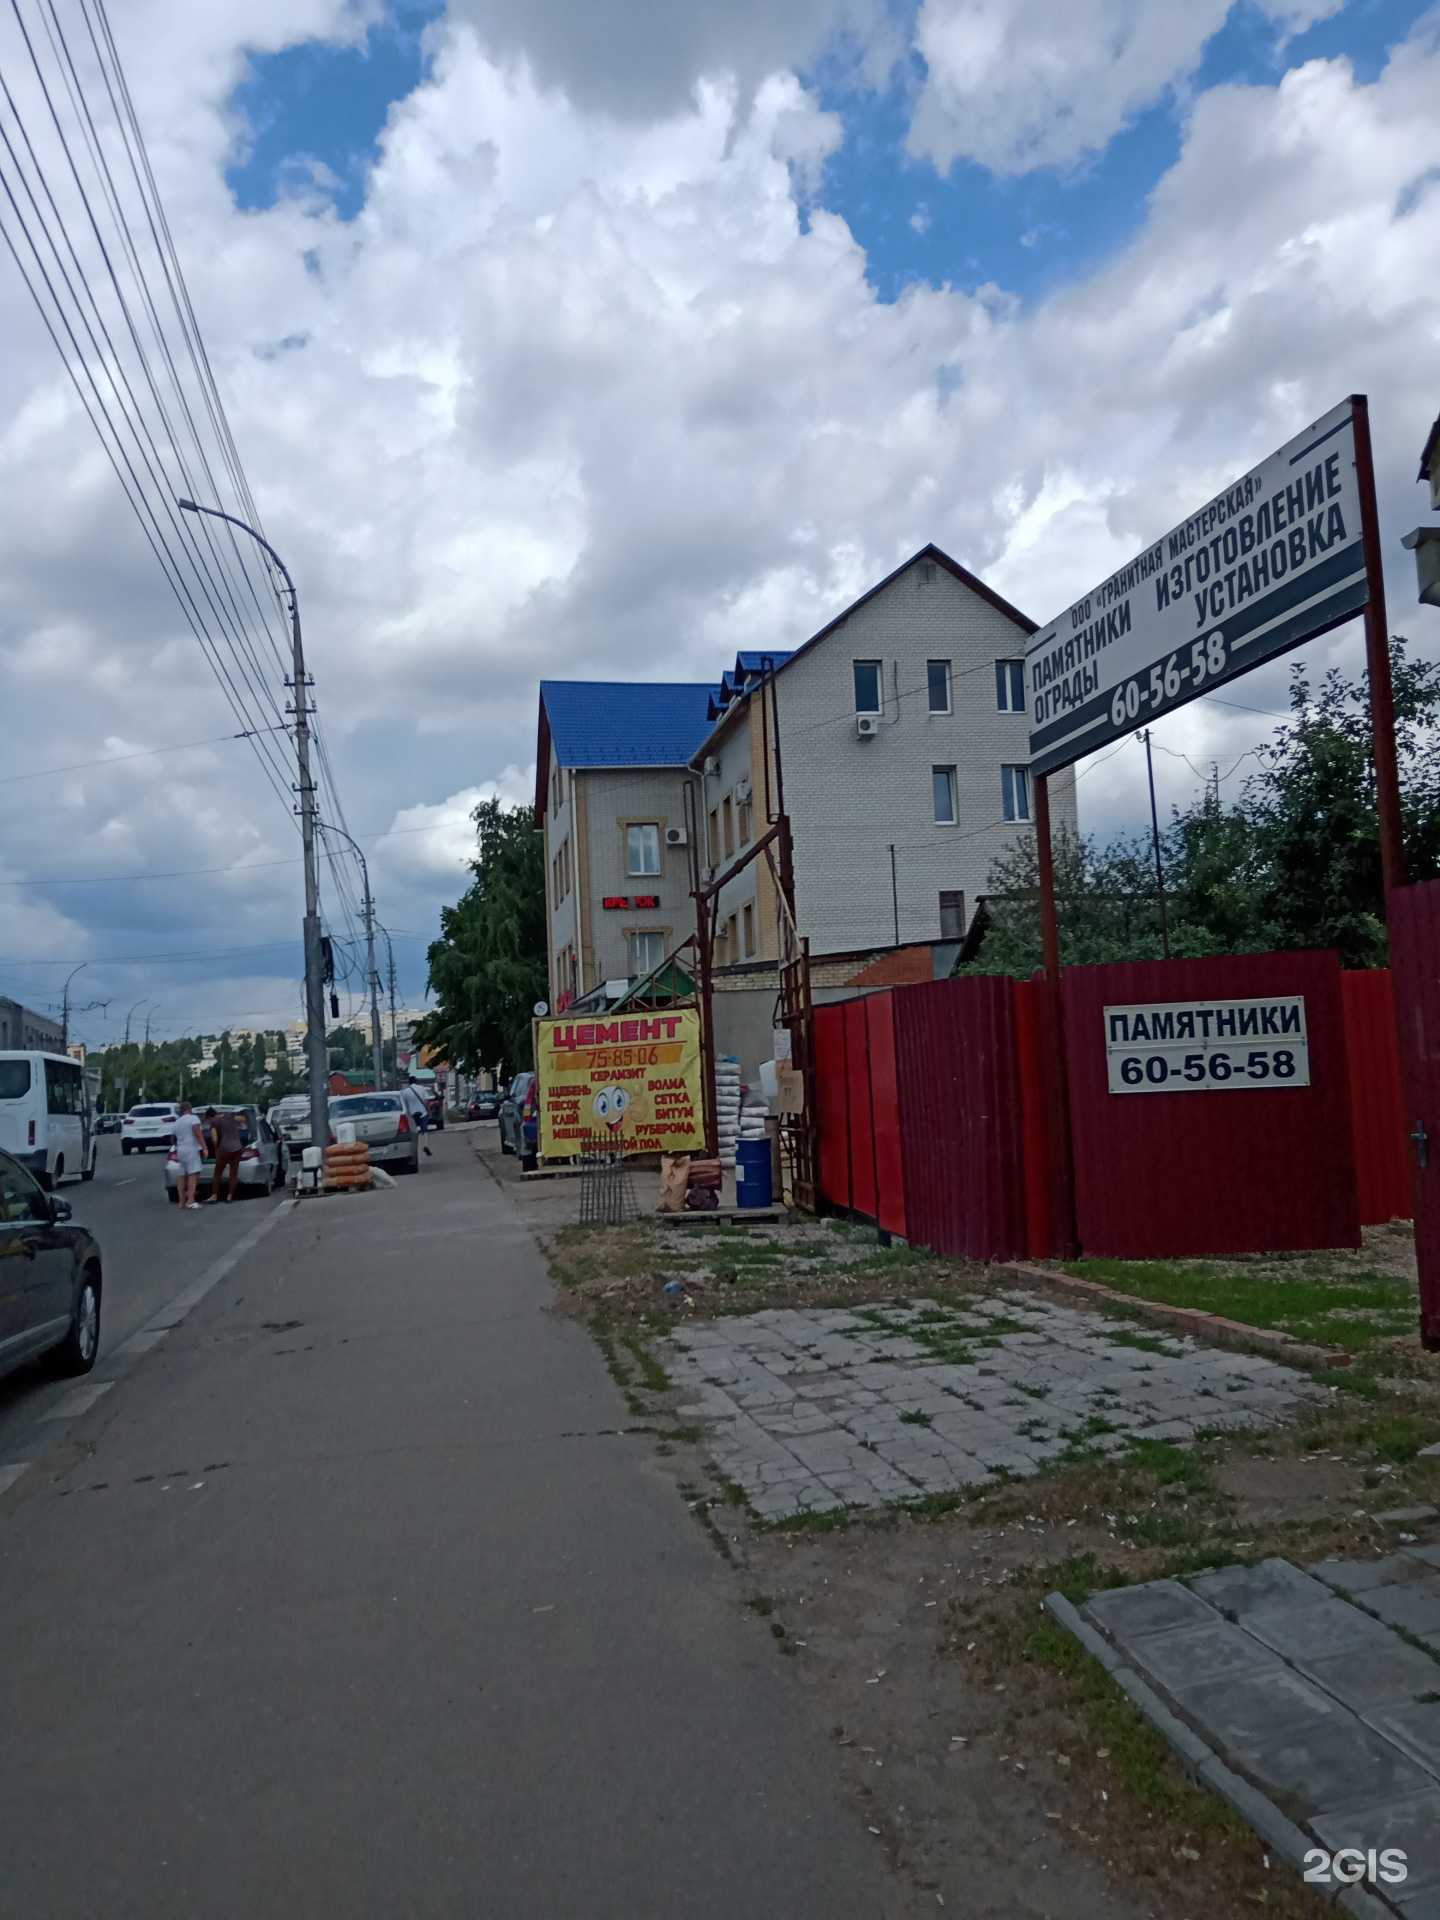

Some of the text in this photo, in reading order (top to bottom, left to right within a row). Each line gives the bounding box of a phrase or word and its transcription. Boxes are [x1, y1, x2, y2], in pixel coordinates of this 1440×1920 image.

[1071, 476, 1262, 629] ООО «ГРАНИТНАЯ МАСТЕРСКАЯ»
[1033, 452, 1342, 692] ПАМЯТНИКИ ИЗГОТОВЛЕНИЕ
[1035, 502, 1347, 724] ОГРАДЫ УСТАНОВКА
[1111, 631, 1226, 726] 60-56-58
[553, 1016, 682, 1051] ЦЕМЕНТ
[1109, 1005, 1301, 1042] ПАМЯТНИКИ
[591, 1068, 646, 1082] КЕРАМЗИТ
[1121, 1050, 1296, 1085] 60-56-58
[654, 1092, 690, 1105] СЕТКА
[655, 1106, 694, 1120] БИТУМ
